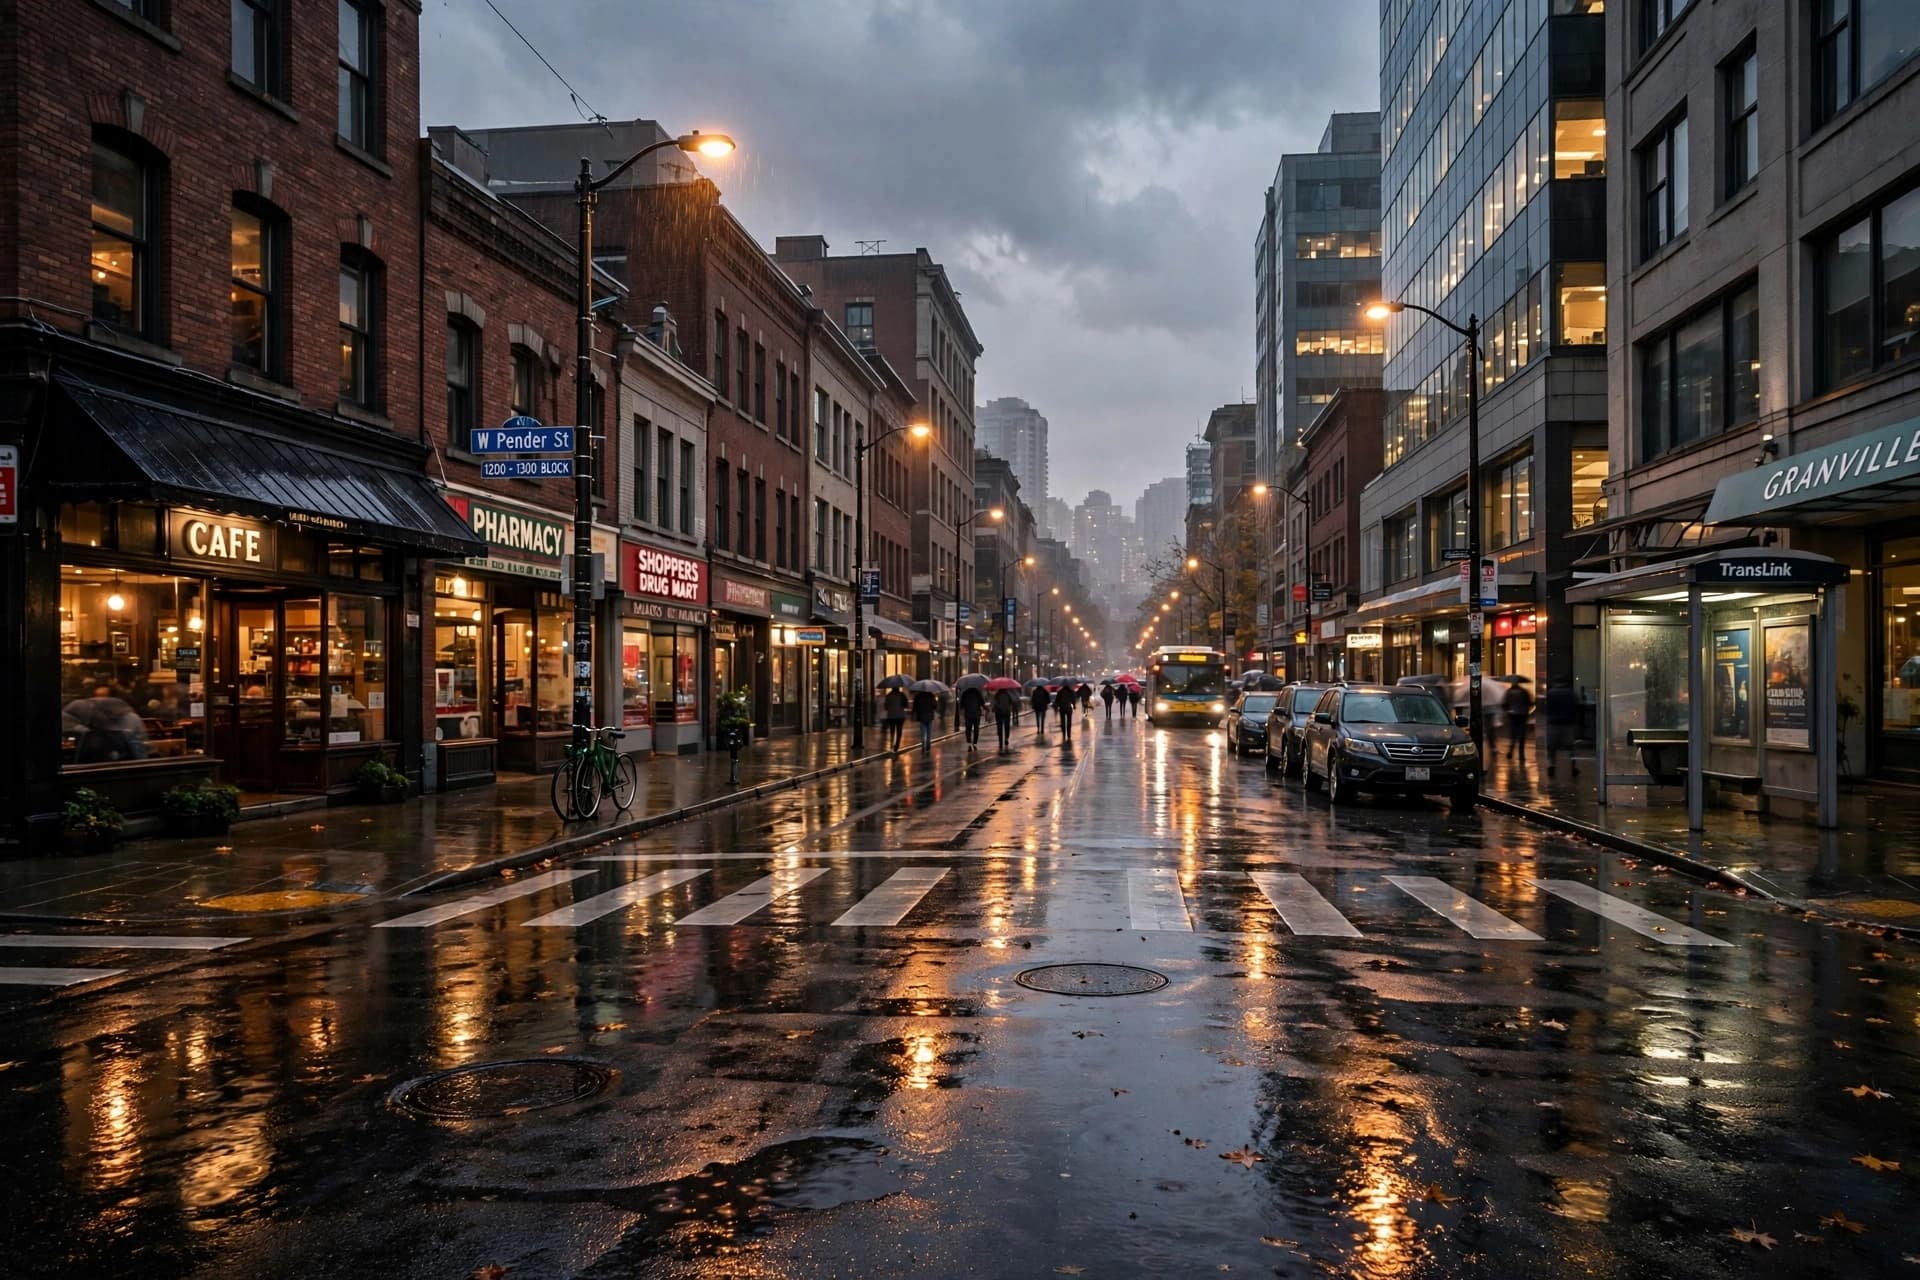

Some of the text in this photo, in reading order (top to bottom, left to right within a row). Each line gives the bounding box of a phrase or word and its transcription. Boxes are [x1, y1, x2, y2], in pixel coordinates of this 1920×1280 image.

[478, 432, 569, 449] W Pender St
[484, 463, 506, 475] 1200
[517, 463, 537, 474] 1300
[541, 463, 569, 474] BLOCK
[1763, 430, 1920, 500] GRANVILLE
[190, 521, 261, 562] CAFE
[473, 507, 562, 556] PHARMACY
[638, 549, 699, 582] SHOPPERS
[1720, 562, 1792, 577] TransLink
[639, 572, 698, 600] DRUG MART
